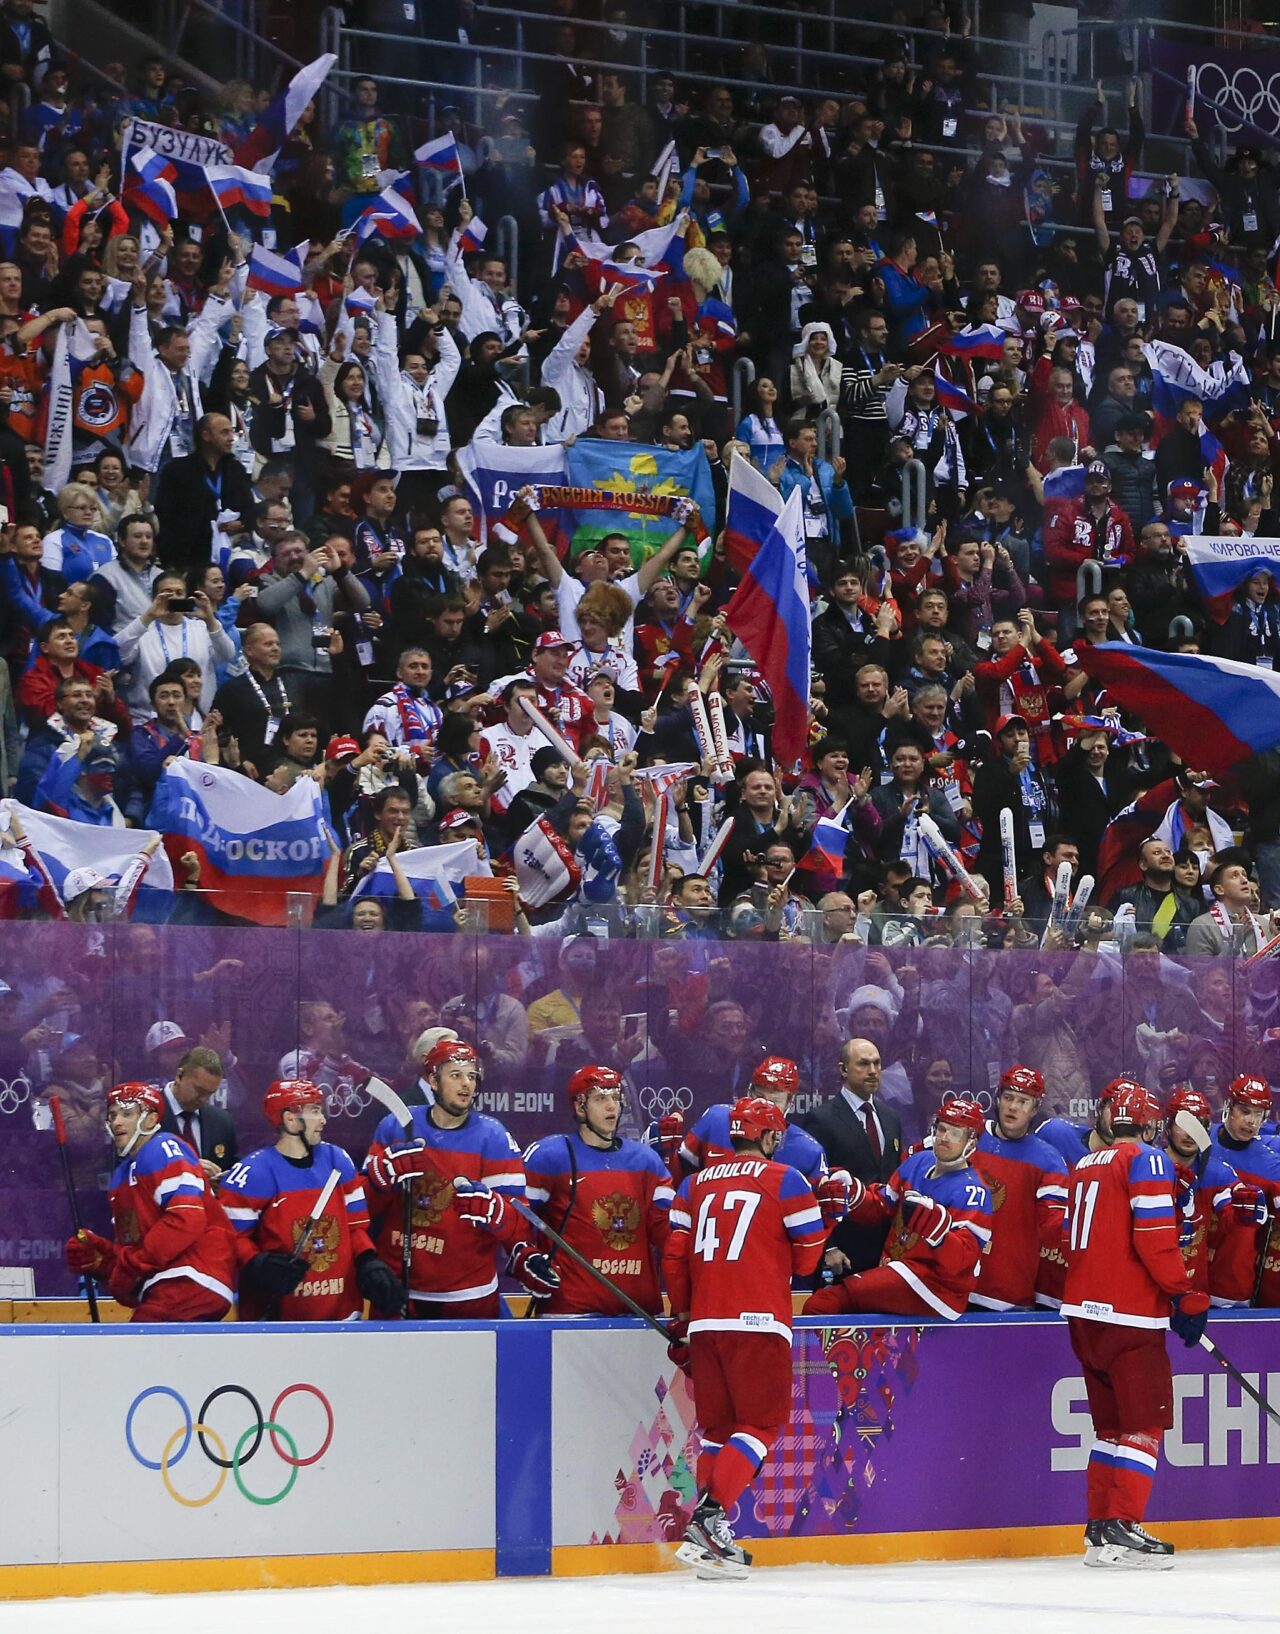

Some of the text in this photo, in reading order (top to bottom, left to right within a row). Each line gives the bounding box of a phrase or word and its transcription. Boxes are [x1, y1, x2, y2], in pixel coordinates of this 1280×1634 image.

[132, 120, 233, 165] БУЗУЛУК
[542, 485, 604, 506] РОССИЯ
[712, 712, 727, 758] MOSCOW
[514, 1091, 554, 1113] 2014
[1118, 1106, 1127, 1116] 11
[731, 1119, 742, 1130] 47
[226, 1162, 251, 1189] 24
[696, 1160, 768, 1185] RADULOV
[1149, 1154, 1165, 1176] 11
[965, 1185, 986, 1207] 27
[694, 1190, 762, 1262] 47
[1070, 1180, 1100, 1251] 11
[592, 1258, 642, 1275] РОССИЯ
